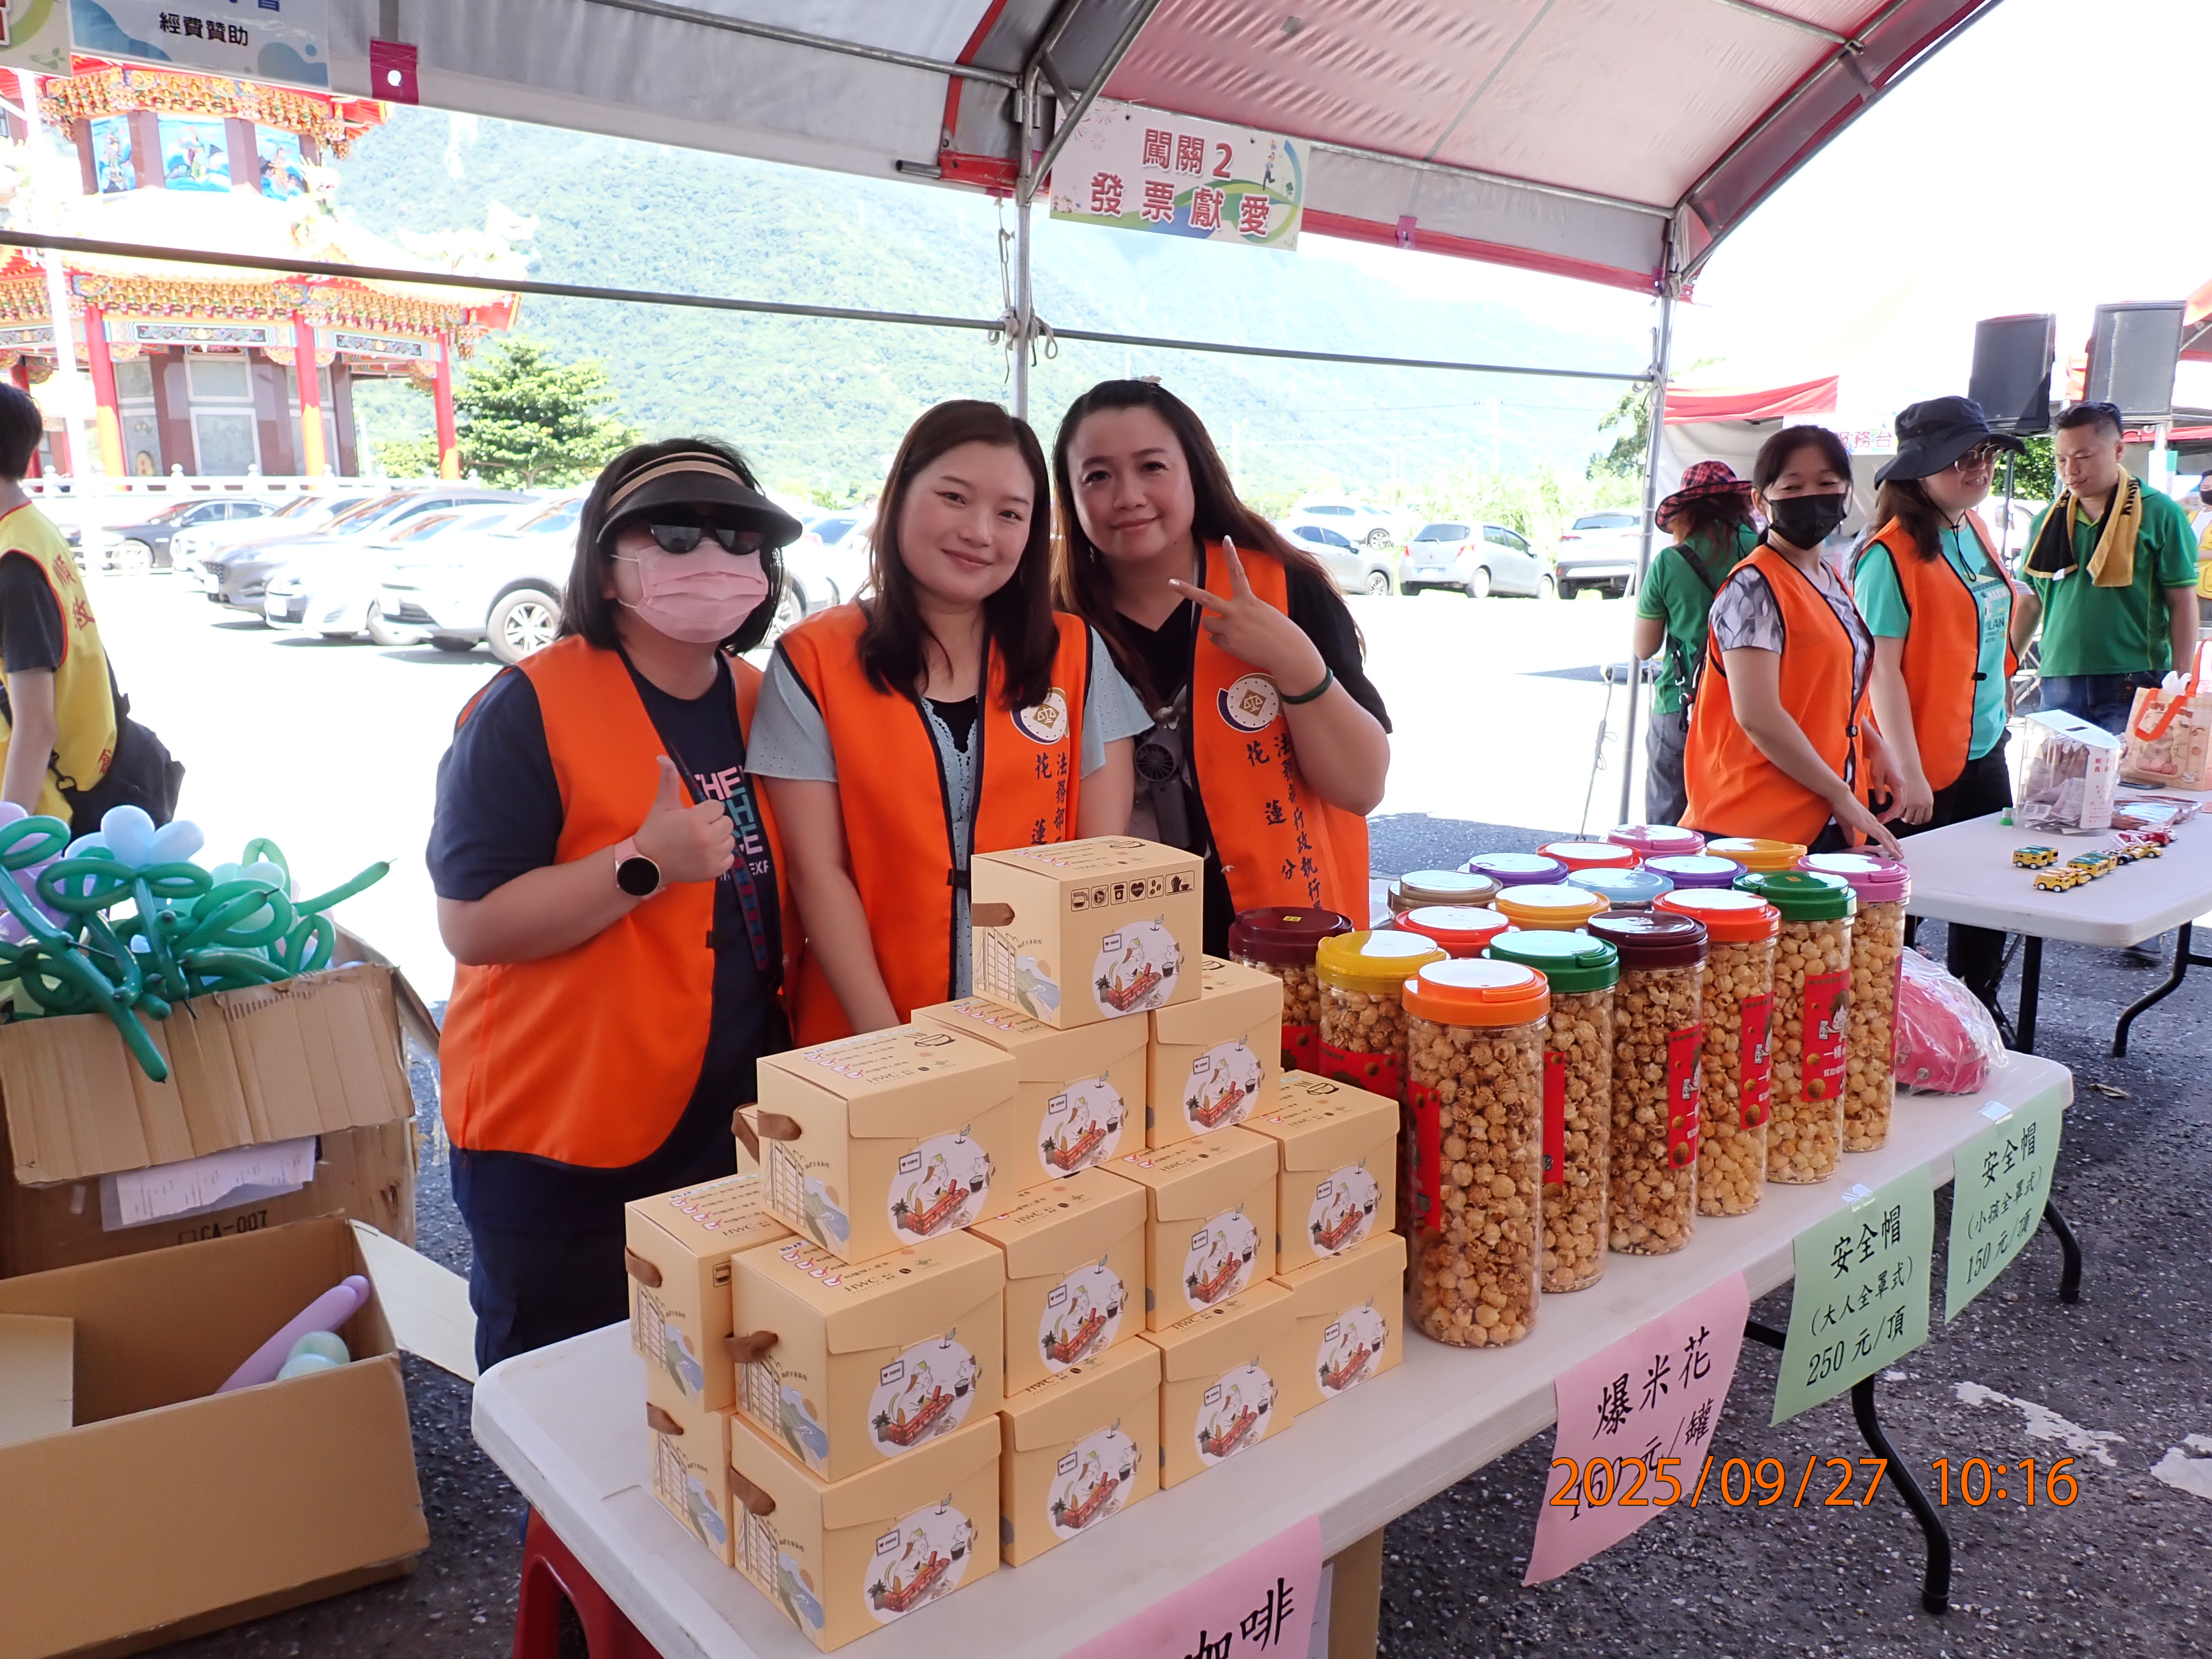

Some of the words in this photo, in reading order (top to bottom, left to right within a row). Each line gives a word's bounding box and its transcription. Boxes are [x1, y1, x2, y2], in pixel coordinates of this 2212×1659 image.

[159, 12, 249, 47] 經費贊助
[1091, 171, 1270, 236] 發票獻愛
[865, 1072, 900, 1084] HWC
[1159, 1160, 1186, 1172] HWC
[1982, 1121, 2036, 1189] 安全帽
[722, 1223, 756, 1237] HWC
[1014, 1211, 1044, 1224] HWC
[1830, 1204, 1901, 1279] 安全帽
[844, 1276, 880, 1292] HWC
[1592, 1326, 1711, 1440] 爆米花
